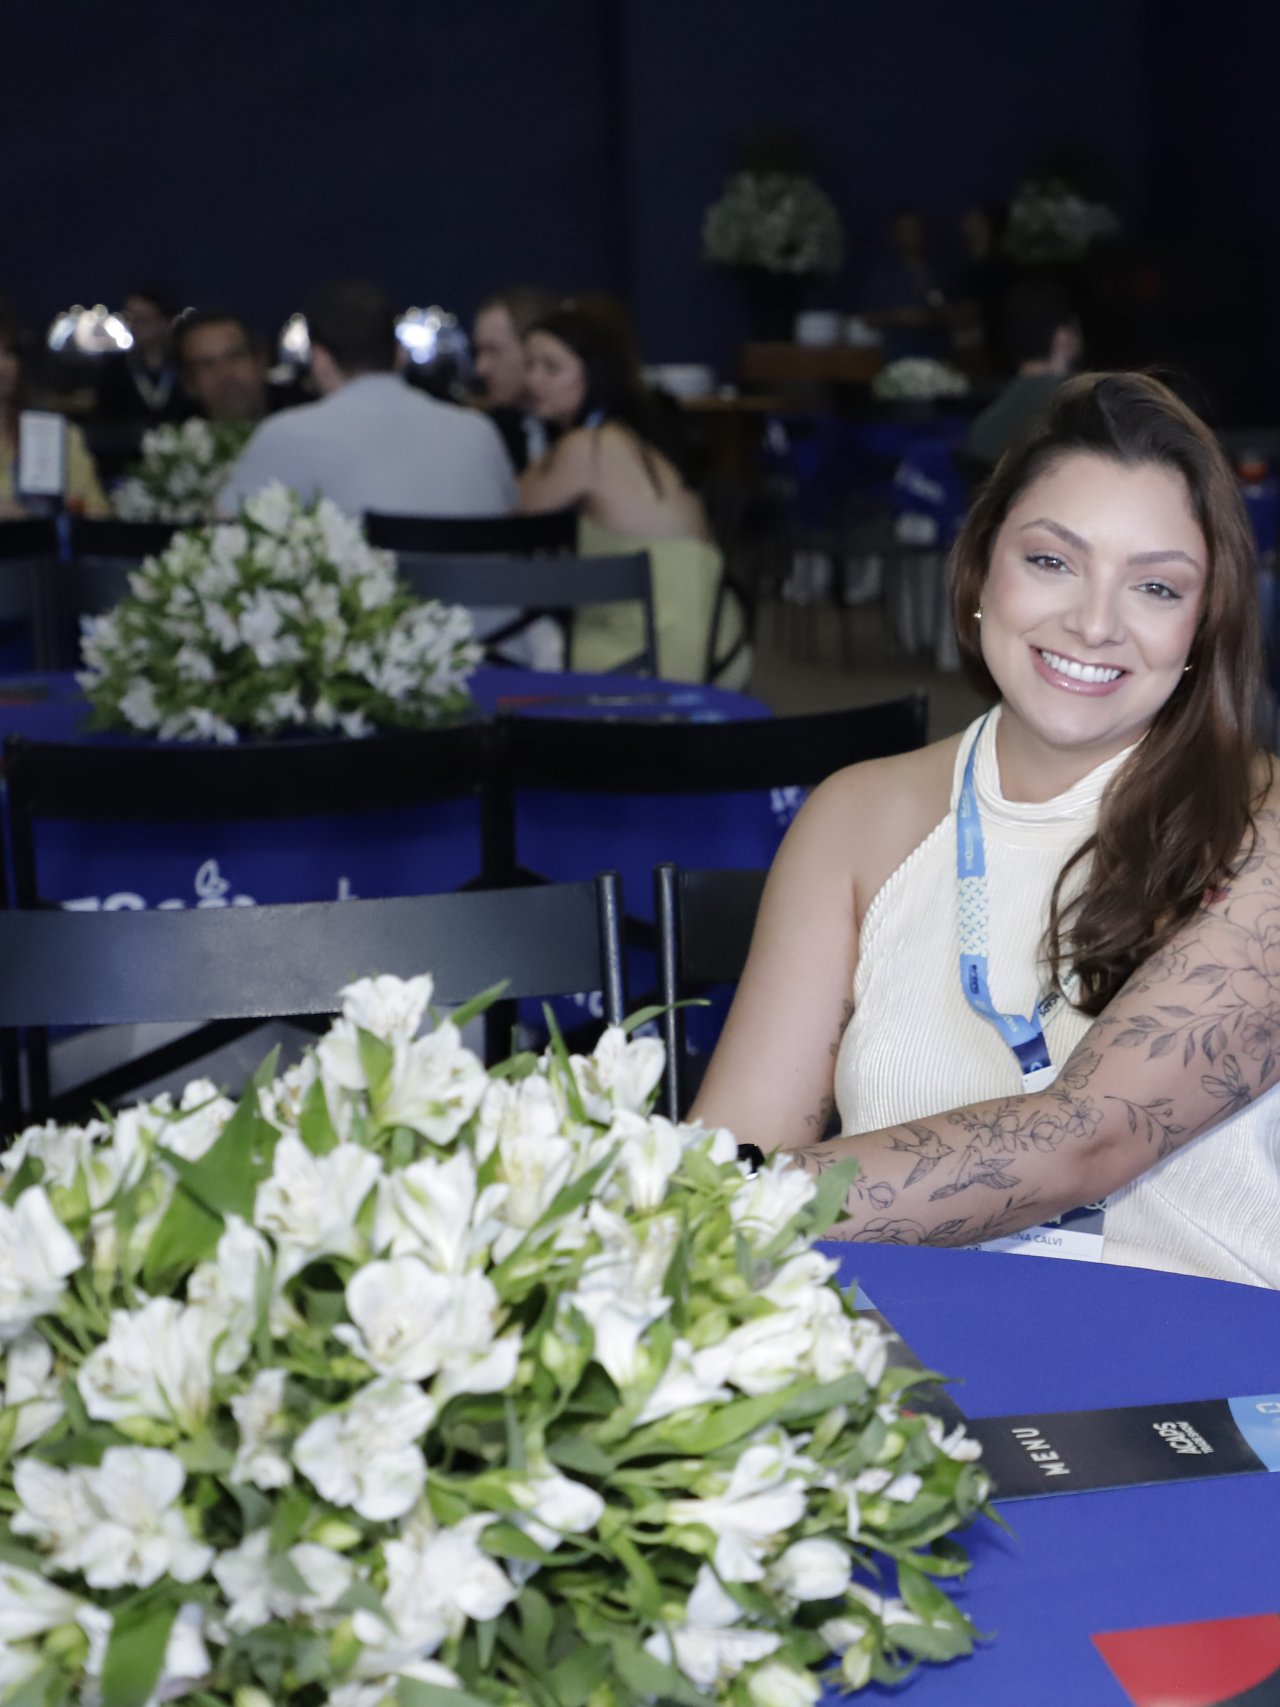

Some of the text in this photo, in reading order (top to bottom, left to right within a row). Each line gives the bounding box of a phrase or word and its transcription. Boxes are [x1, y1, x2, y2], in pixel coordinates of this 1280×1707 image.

[1034, 1234, 1063, 1246] CALVI
[1011, 1427, 1071, 1476] MENU
[1152, 1421, 1202, 1455] ACAPS
